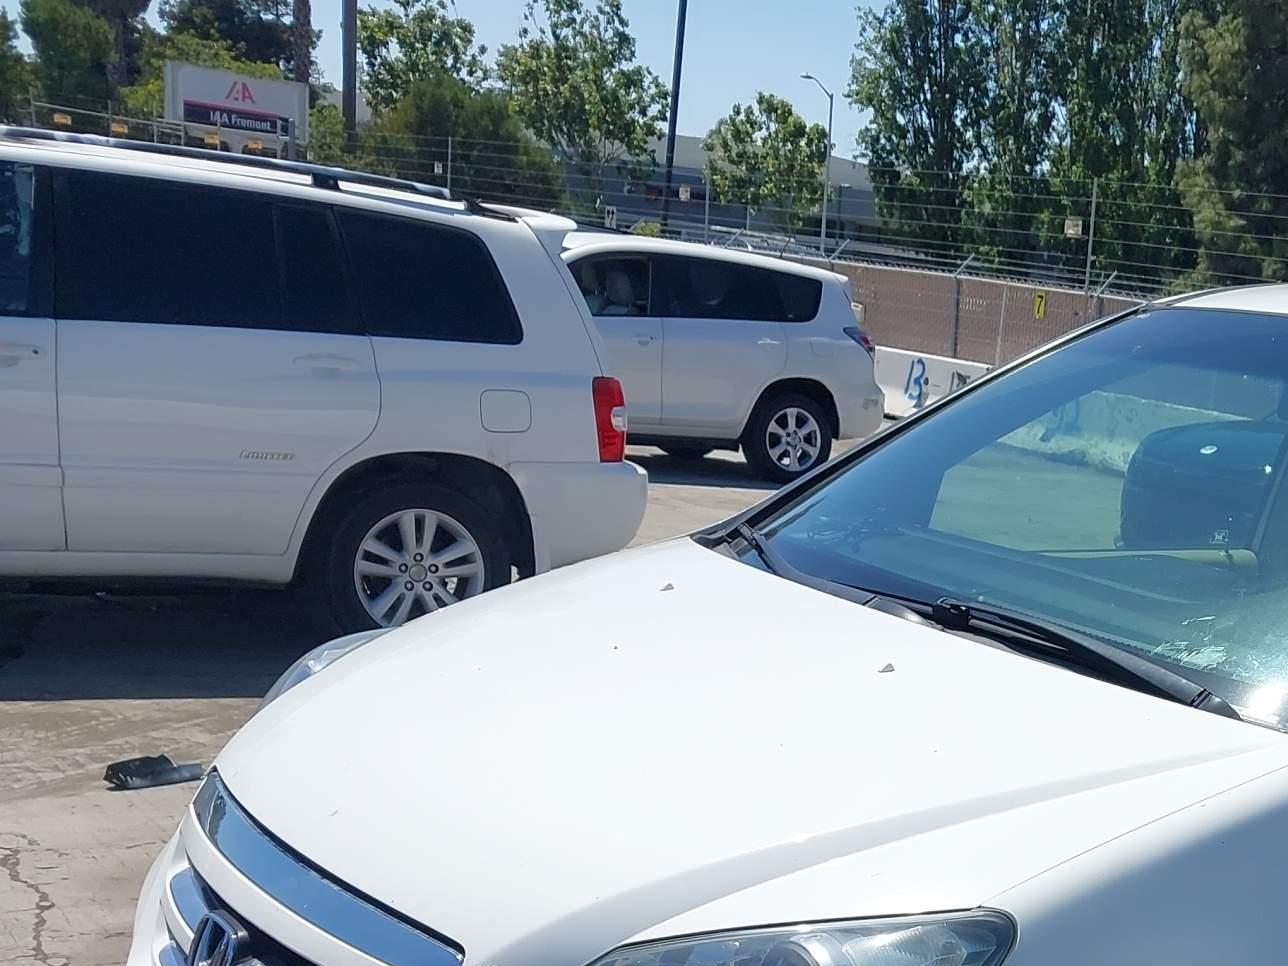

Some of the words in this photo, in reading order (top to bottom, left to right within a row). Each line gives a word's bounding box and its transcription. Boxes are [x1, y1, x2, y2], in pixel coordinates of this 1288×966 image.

[209, 110, 230, 126] IAA
[231, 113, 272, 130] Fremont
[1036, 294, 1045, 314] 7
